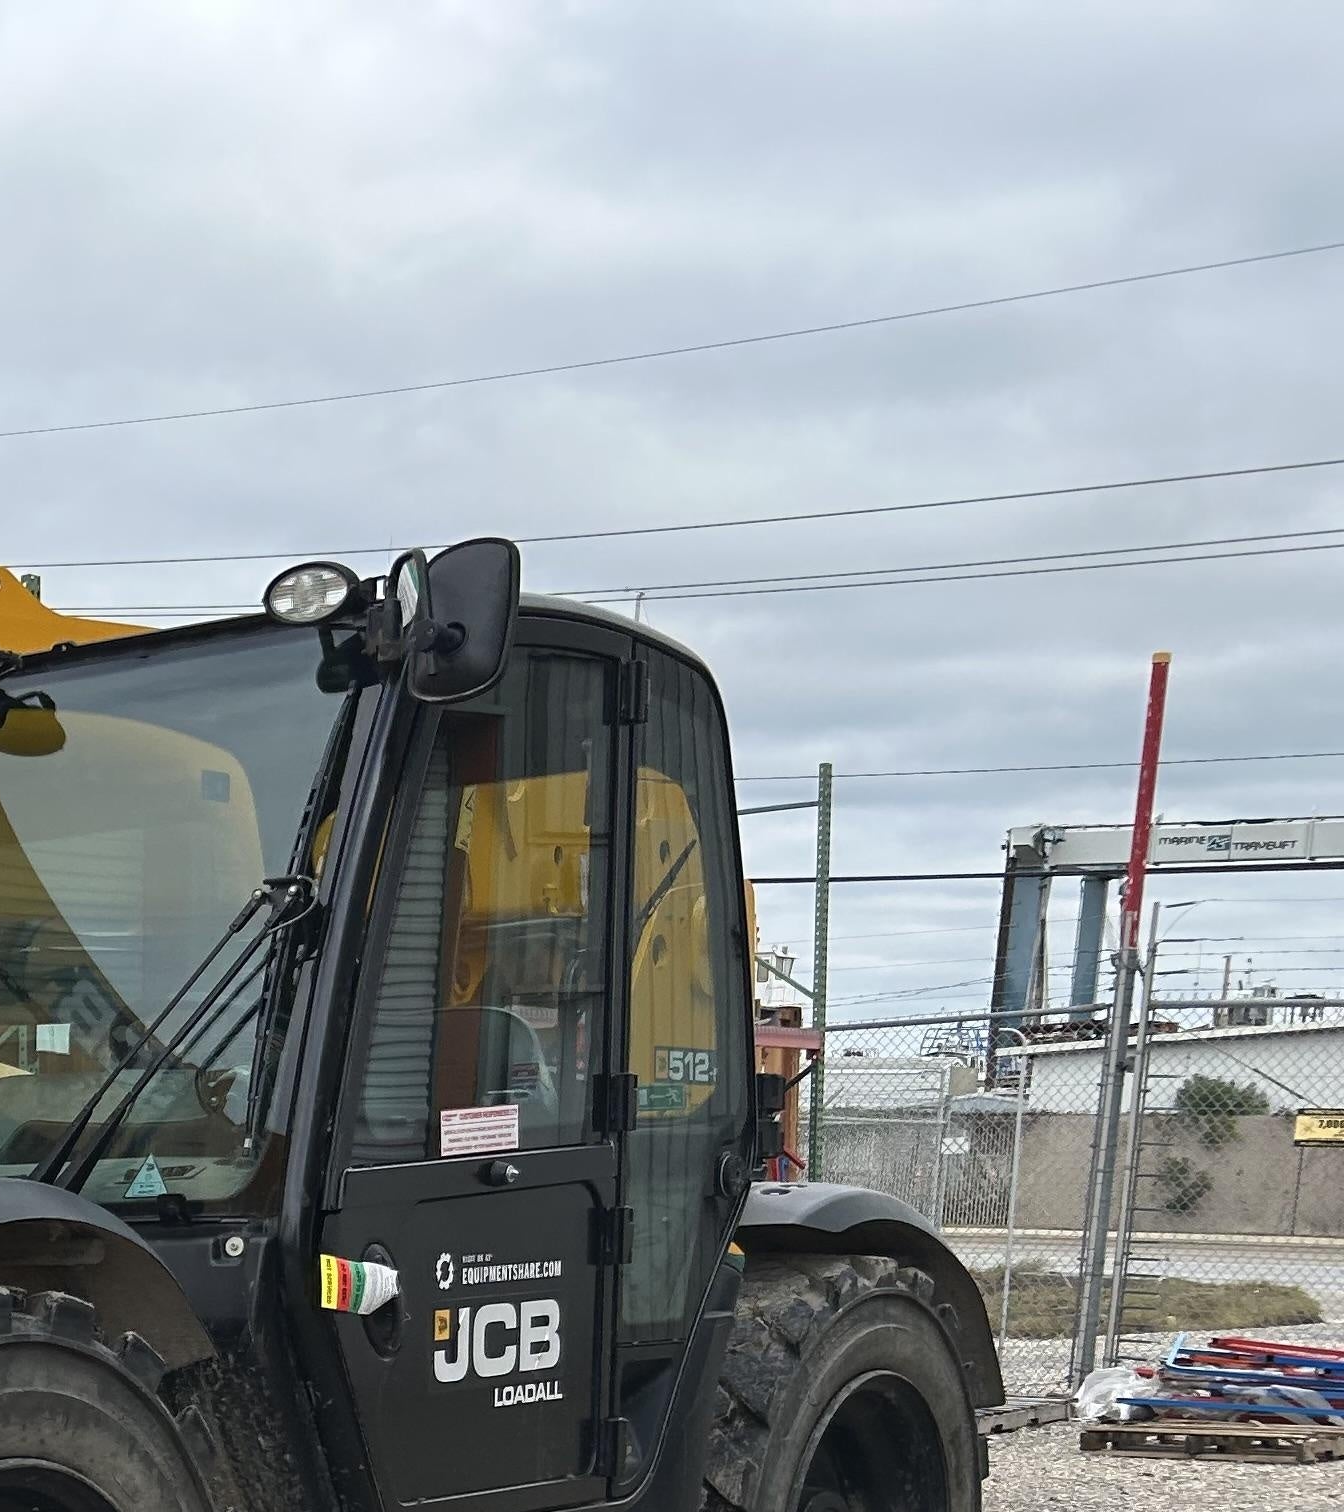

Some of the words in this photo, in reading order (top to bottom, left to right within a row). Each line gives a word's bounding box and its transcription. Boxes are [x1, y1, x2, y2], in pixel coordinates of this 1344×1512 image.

[461, 1260, 562, 1285] EQUIPMENTSHARE.COM
[433, 1299, 561, 1383] JCB
[494, 1380, 563, 1408] LOADALL
